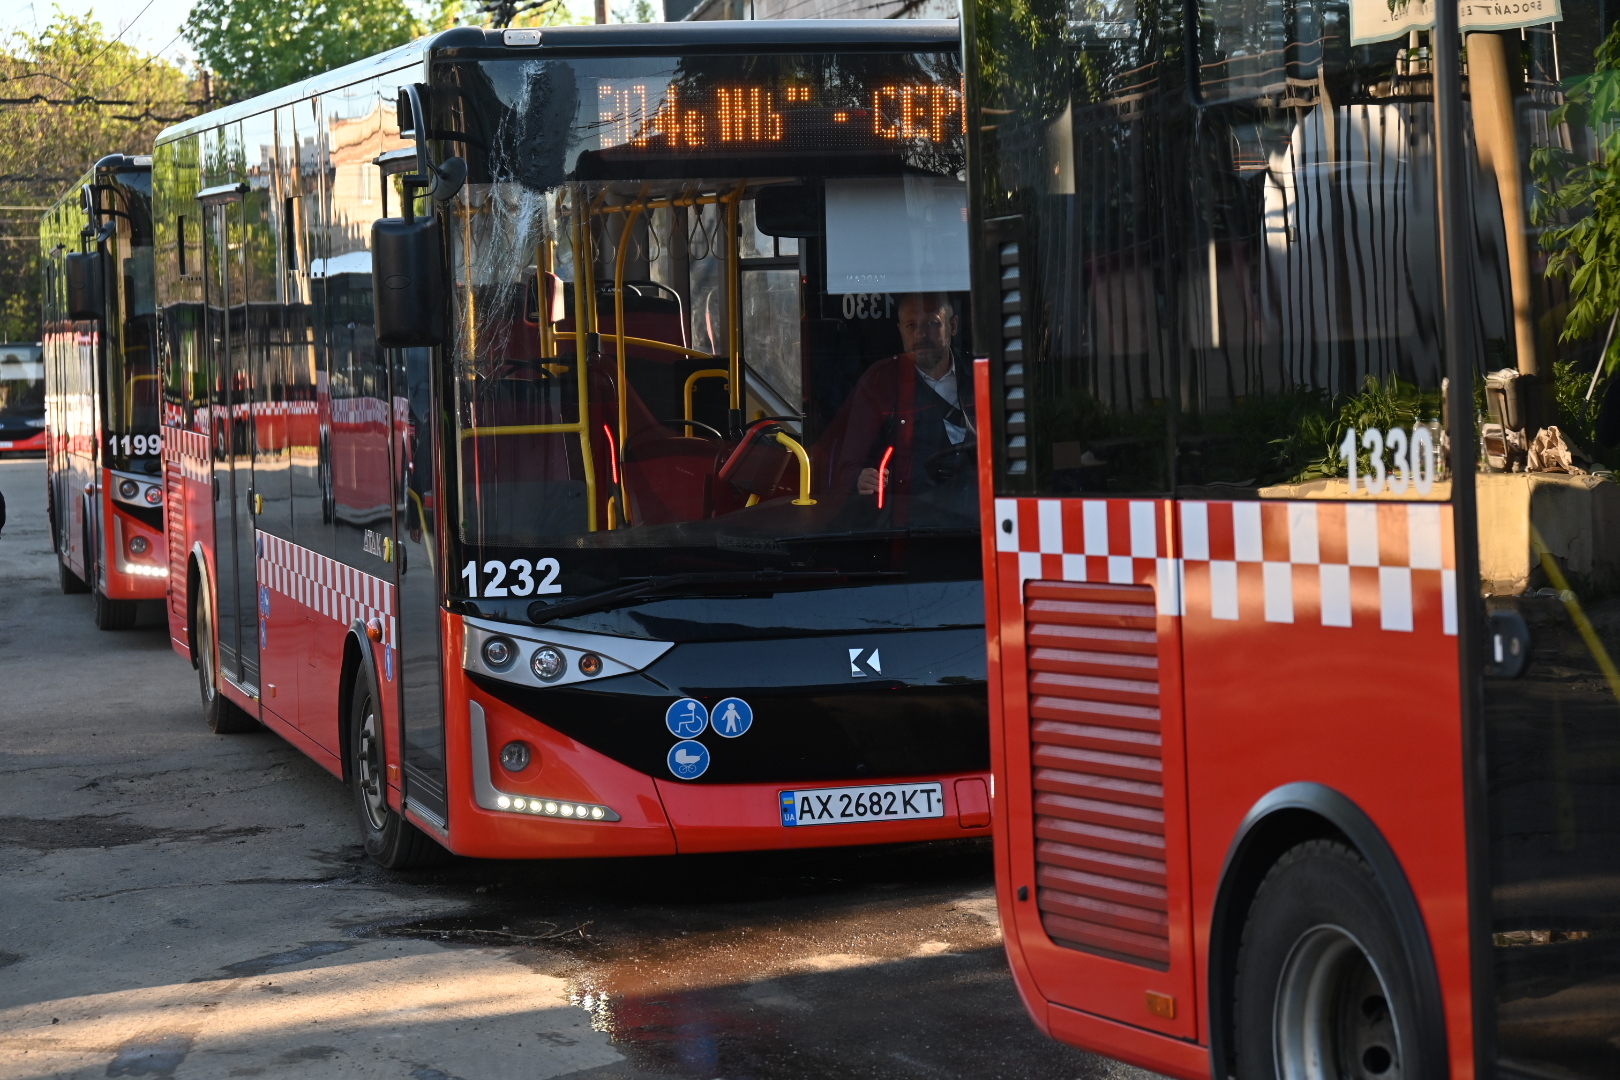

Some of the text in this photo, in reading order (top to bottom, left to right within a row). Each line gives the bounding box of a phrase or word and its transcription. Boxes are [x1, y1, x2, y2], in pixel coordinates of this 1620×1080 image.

[109, 434, 162, 456] 1199
[1339, 426, 1434, 496] 1330
[363, 528, 382, 557] ATAK
[461, 557, 562, 598] 1232
[784, 788, 937, 822] UA AX 2682 KT
